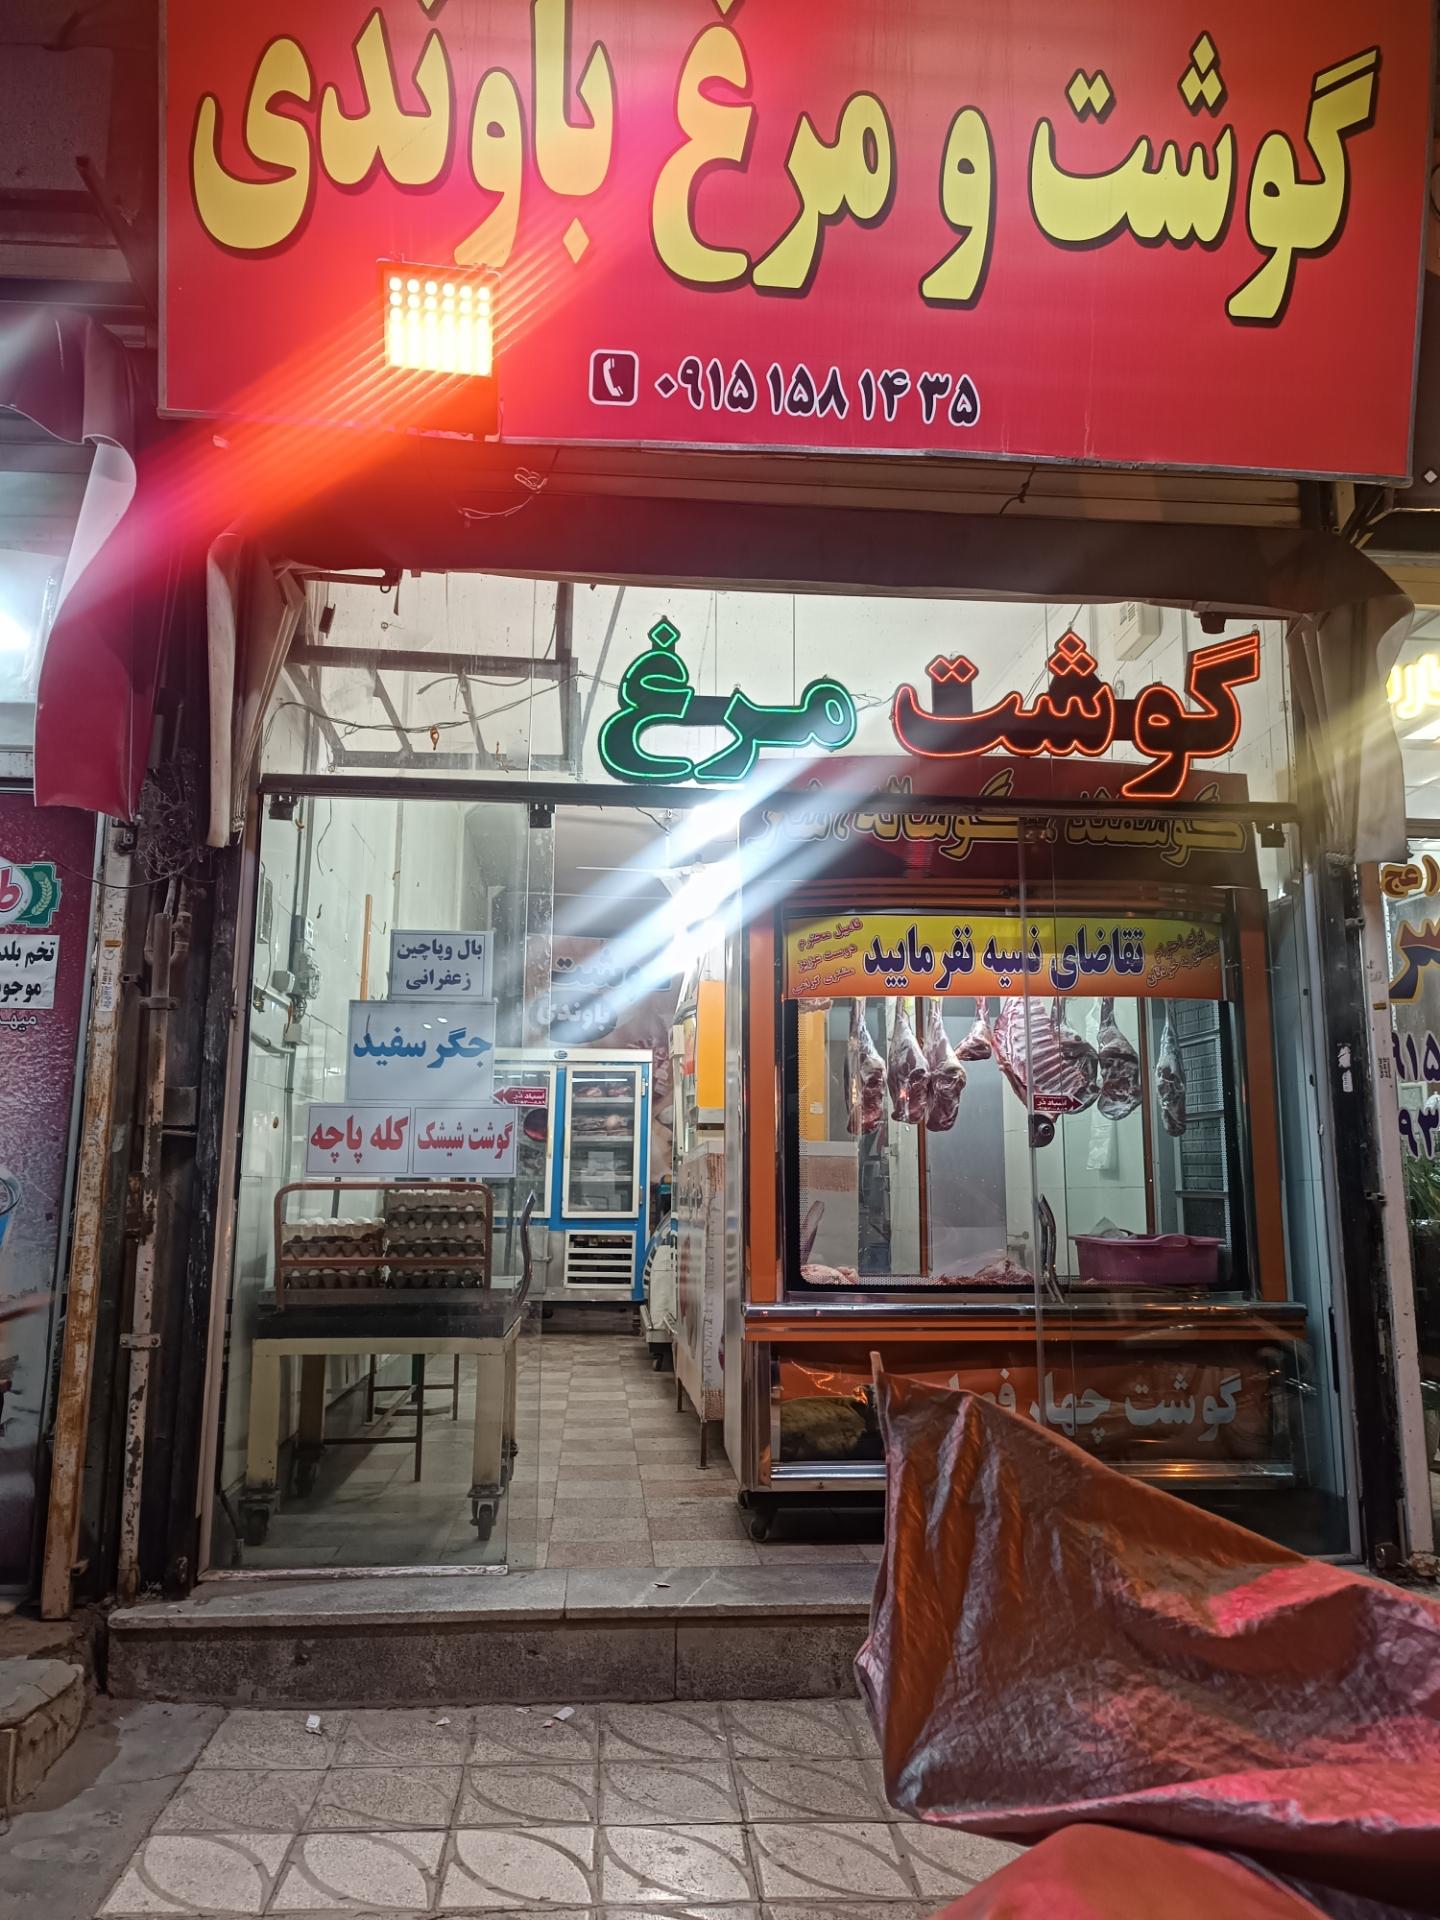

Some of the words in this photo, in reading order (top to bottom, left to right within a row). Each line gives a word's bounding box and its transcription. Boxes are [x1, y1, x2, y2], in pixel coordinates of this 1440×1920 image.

[188, 0, 616, 268] باوندی
[649, 0, 896, 293] مرغ
[919, 105, 996, 308] و
[1029, 29, 1381, 326] گوشت
[655, 356, 757, 413] ۰۹۱۵
[766, 362, 849, 420] ۱۵۸
[858, 368, 911, 421] ۱۴
[917, 371, 981, 427] ۳۵
[598, 618, 858, 785] مرغ
[891, 627, 1261, 799] گوشت
[25, 941, 56, 968] تخم
[405, 969, 472, 990] زعفرانی
[457, 938, 483, 959] بال
[862, 923, 977, 991] نفرمایید
[981, 924, 1043, 990] نسیه
[1049, 923, 1146, 990] تقاضای
[0, 981, 42, 1003] موجو
[353, 1026, 427, 1066] سفید
[427, 1027, 493, 1068] جگر
[310, 1114, 364, 1163] پاچه
[370, 1115, 409, 1150] کله
[468, 1121, 513, 1159] گوشت
[1125, 1368, 1242, 1442] گوشت
